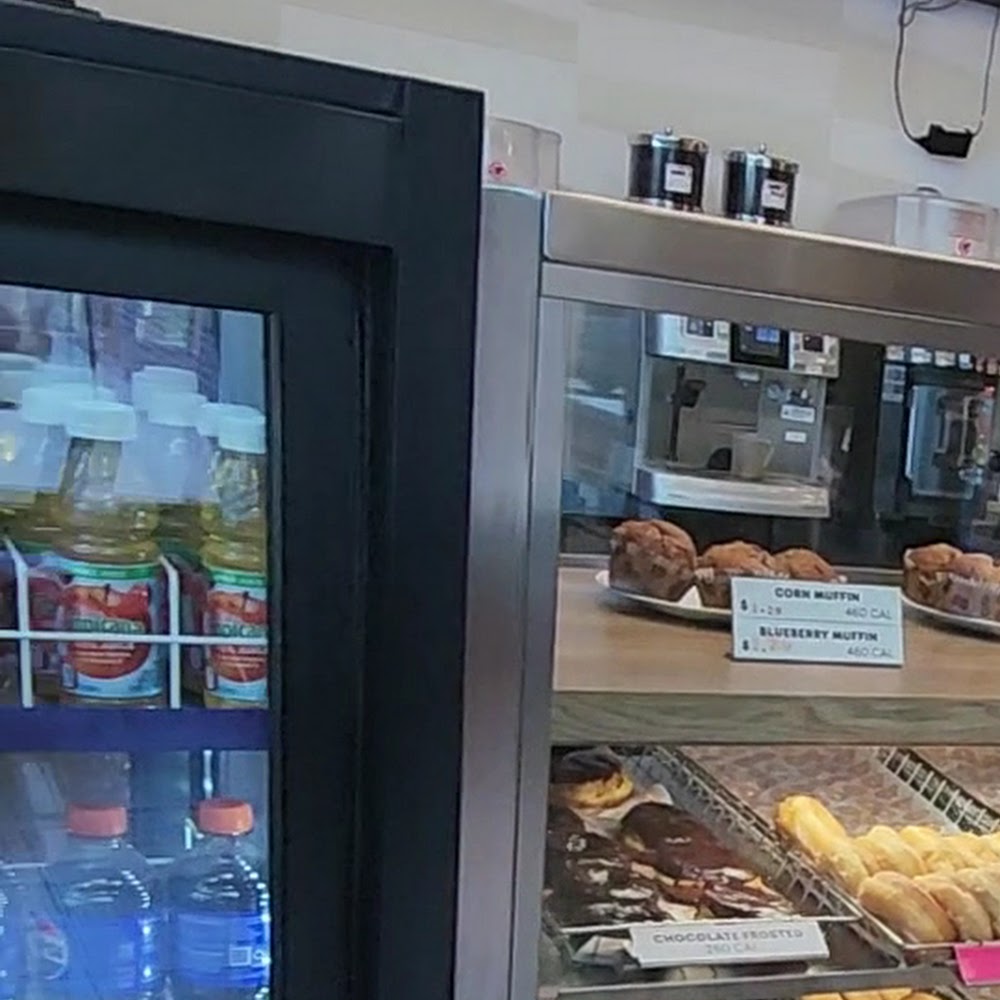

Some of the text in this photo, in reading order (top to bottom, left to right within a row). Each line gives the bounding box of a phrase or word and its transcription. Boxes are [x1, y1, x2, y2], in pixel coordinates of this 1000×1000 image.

[775, 587, 860, 602] CORN MUFFIN
[870, 608, 893, 620] CAL
[759, 626, 878, 641] BLUEBERRY MUFFIN
[652, 928, 804, 944] CHOCOLATE FROSTED
